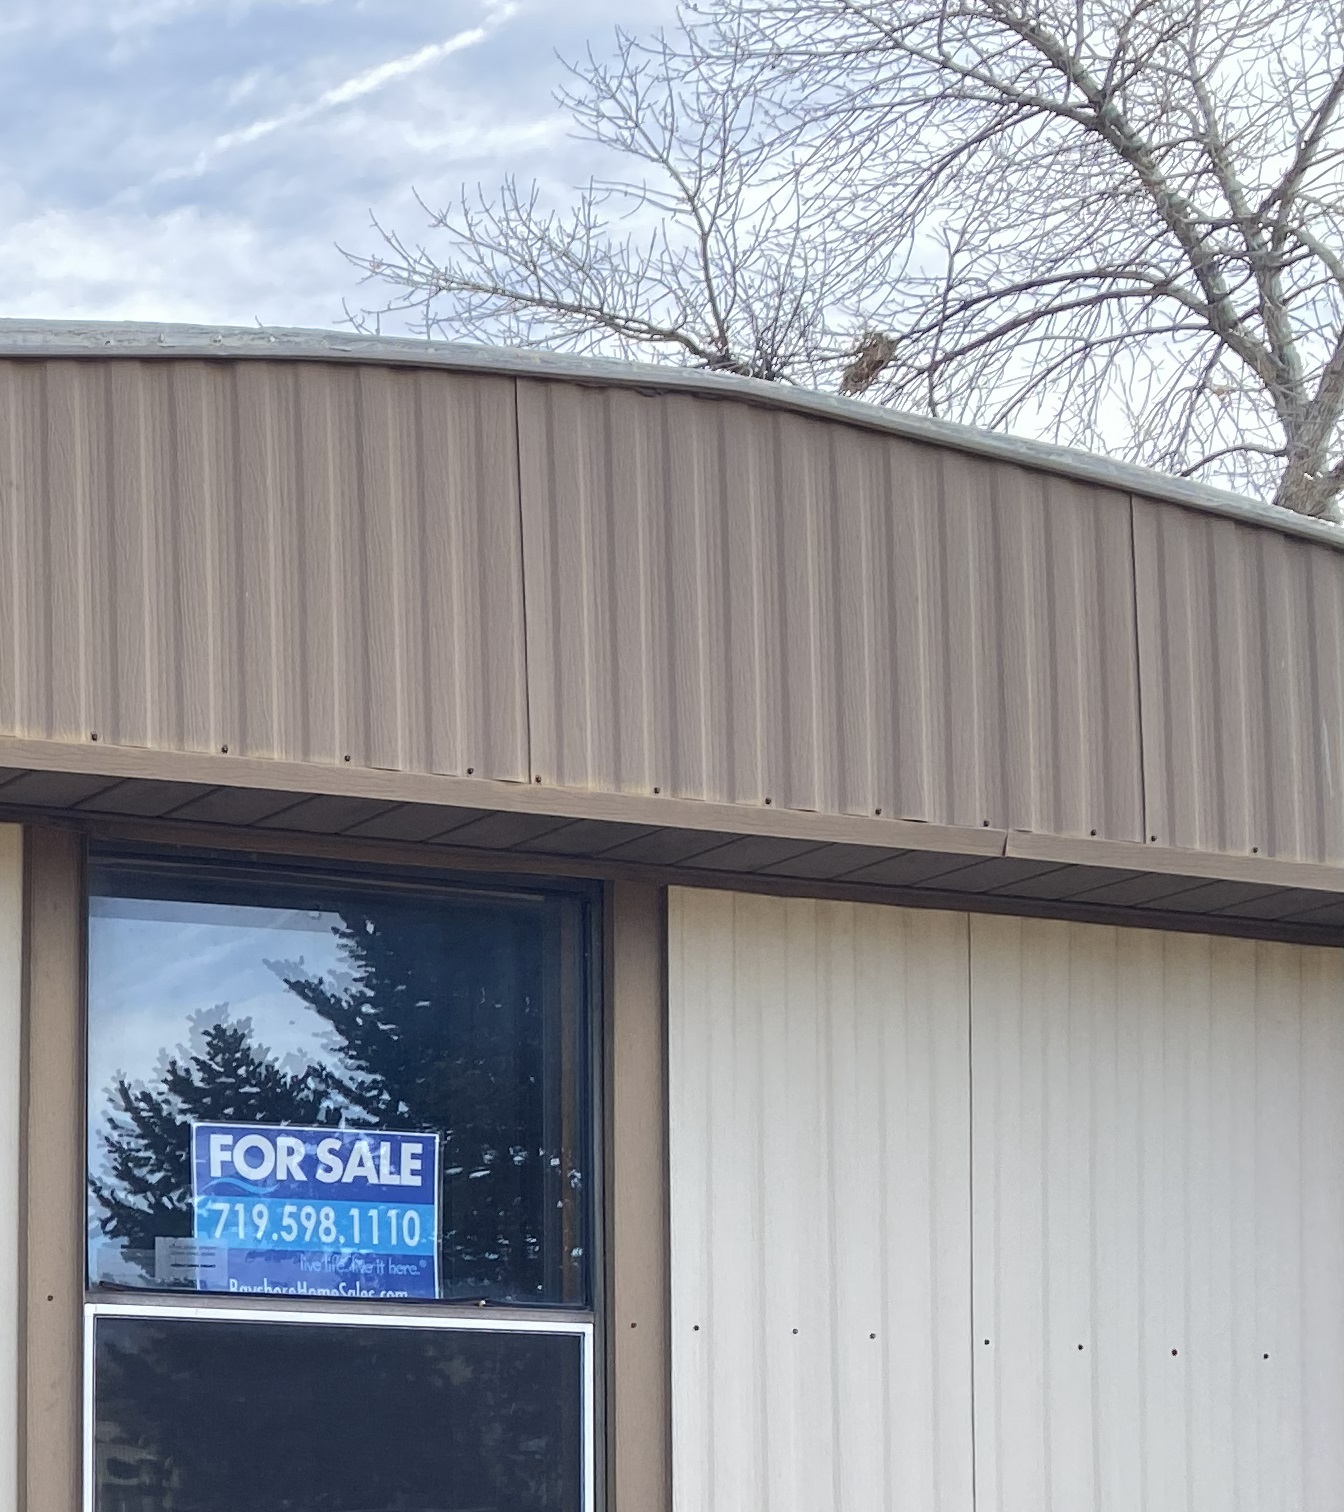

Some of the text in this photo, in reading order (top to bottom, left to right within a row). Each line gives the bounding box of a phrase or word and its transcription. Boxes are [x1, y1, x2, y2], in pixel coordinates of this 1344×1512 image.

[209, 1134, 423, 1187] FOR SALE
[212, 1202, 421, 1247] 719.598.1110
[300, 1252, 322, 1272] live
[375, 1258, 385, 1275] it
